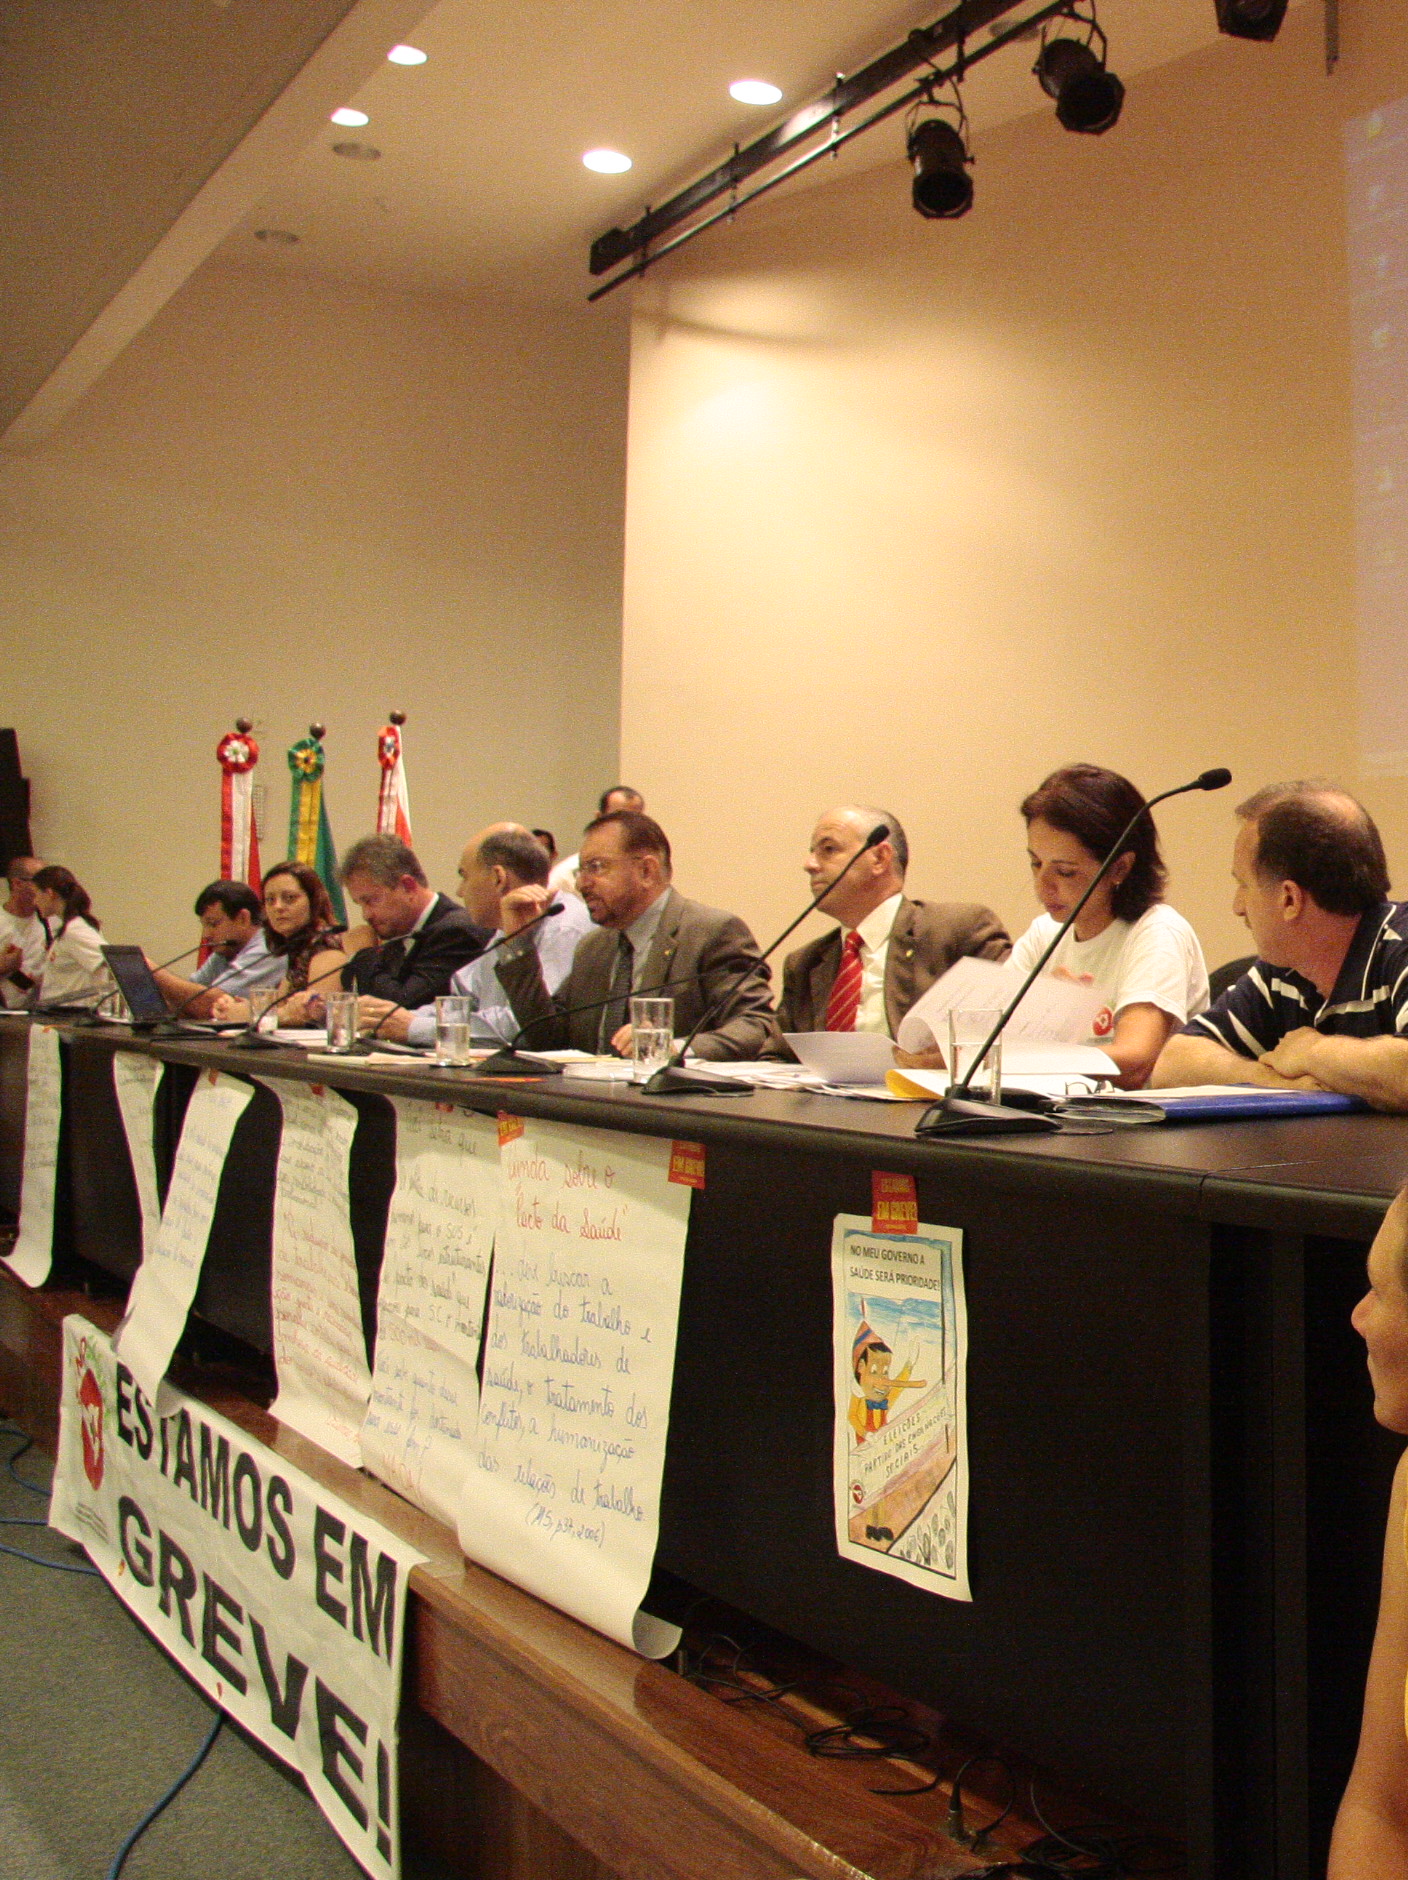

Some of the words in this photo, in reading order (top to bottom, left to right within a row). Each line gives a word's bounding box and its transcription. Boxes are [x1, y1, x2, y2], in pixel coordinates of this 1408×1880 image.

[551, 1200, 572, 1234] da
[850, 1244, 862, 1257] NO
[862, 1246, 880, 1260] MEU
[880, 1248, 919, 1265] GOVERNO
[919, 1253, 926, 1265] A
[601, 1277, 614, 1296] a
[849, 1265, 874, 1281] SAÚDE
[875, 1268, 896, 1285] SERÁ
[895, 1272, 942, 1292] PRIORIDADE!
[553, 1289, 570, 1321] do
[579, 1295, 632, 1336] trabalho
[521, 1328, 601, 1370] trabalhadores
[616, 1345, 631, 1375] de
[543, 1375, 615, 1418] tratamento
[625, 1392, 648, 1430] dos
[546, 1412, 637, 1474] humanização
[570, 1469, 586, 1505] de
[593, 1479, 645, 1522] trabalho
[314, 1504, 398, 1667] EM
[117, 1495, 392, 1868] GREVE!
